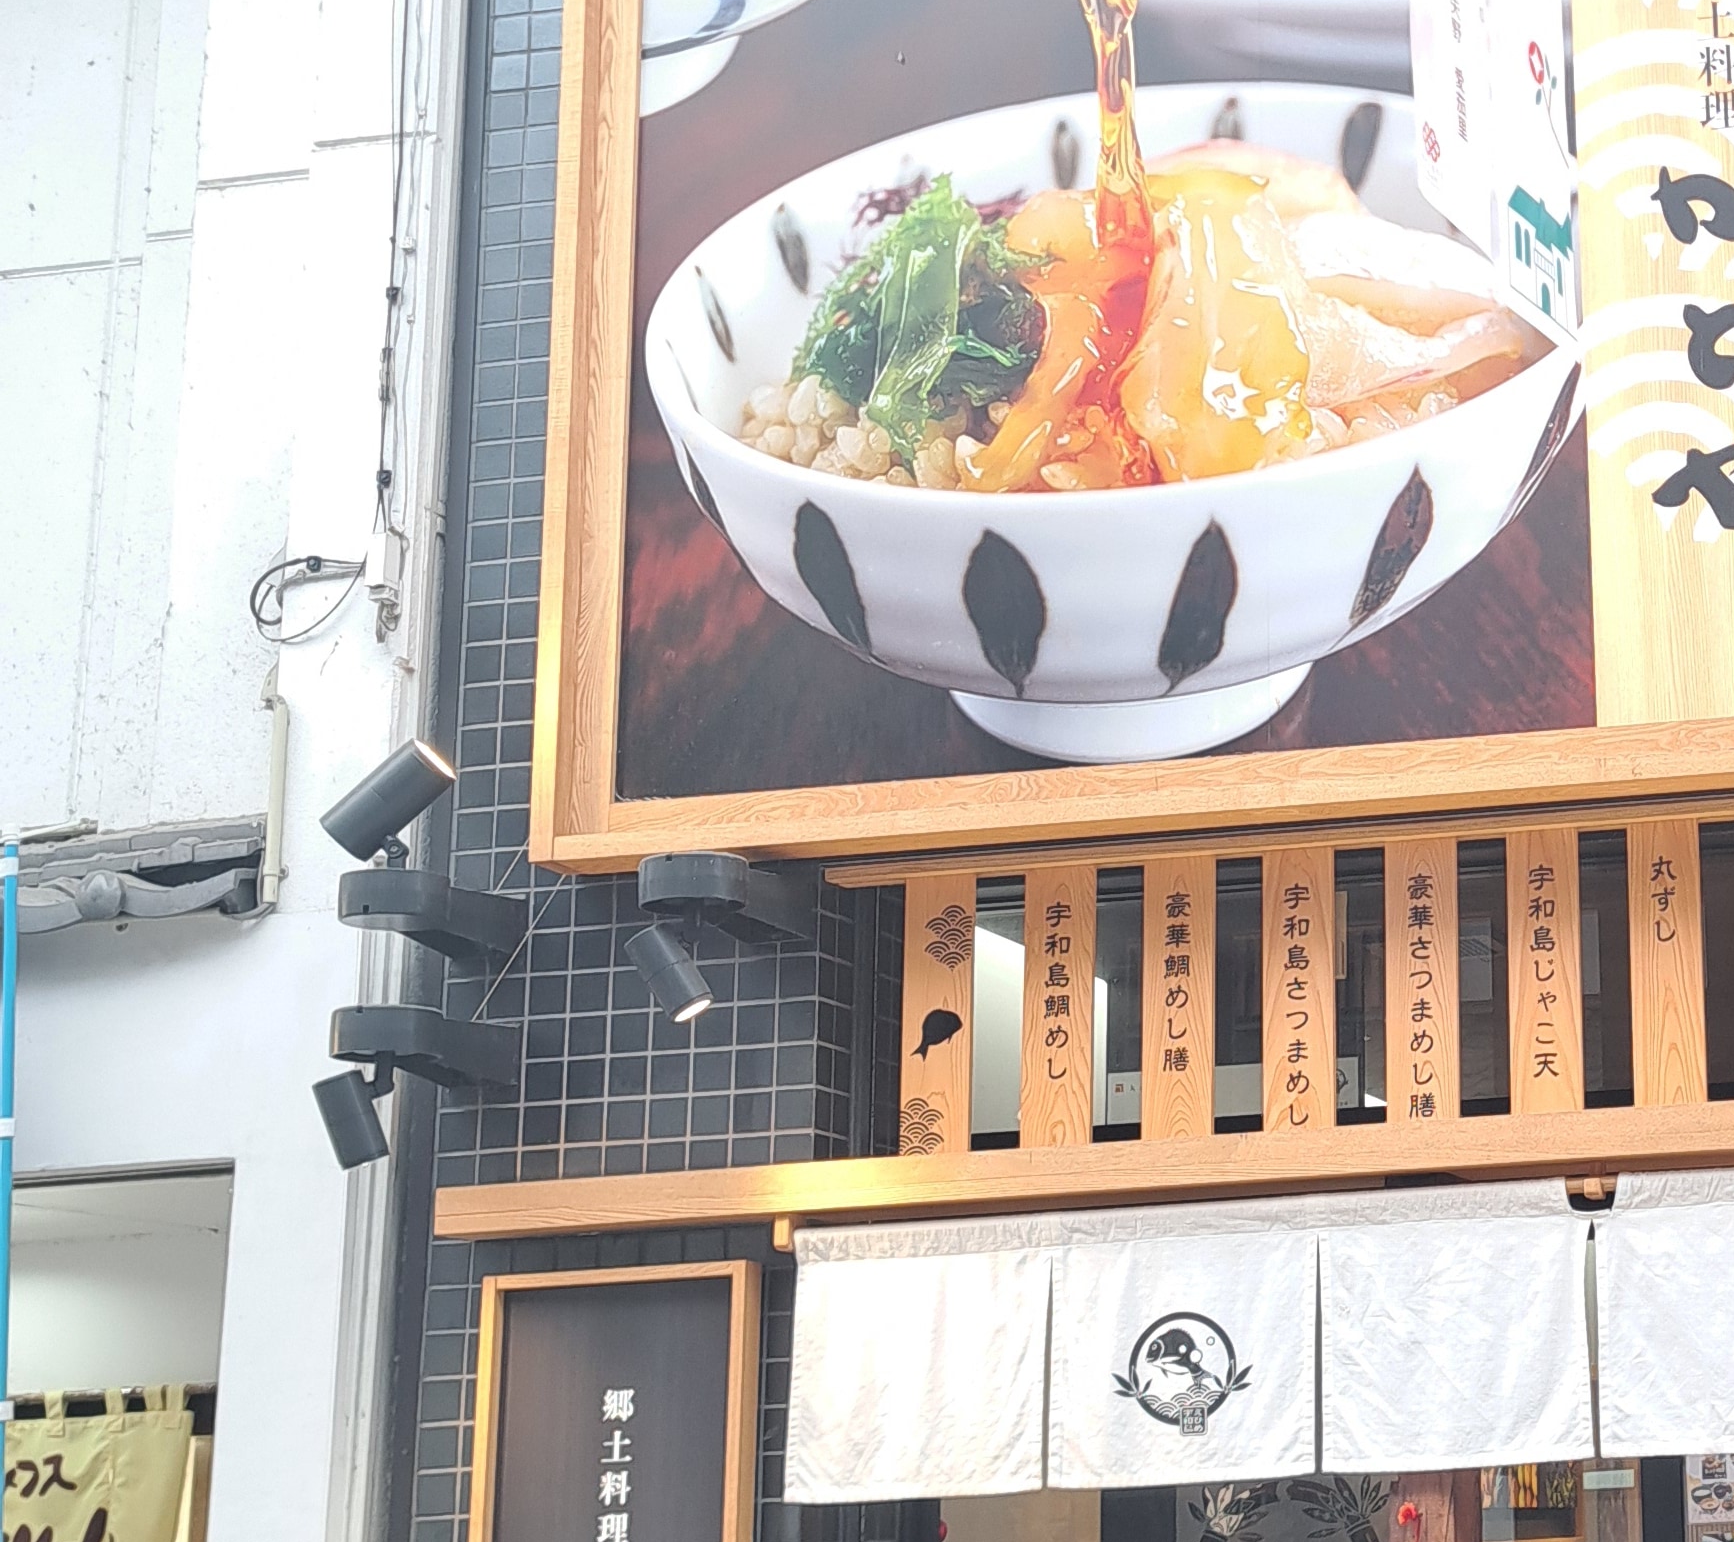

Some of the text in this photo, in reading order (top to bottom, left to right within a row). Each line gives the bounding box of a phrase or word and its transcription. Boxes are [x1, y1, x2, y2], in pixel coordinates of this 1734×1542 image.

[1043, 900, 1071, 1081] 宇和島鯛めし
[1162, 891, 1192, 1073] 豪華鯛めし膳
[1407, 872, 1436, 1119] 豪華さつまめし膳
[1527, 863, 1560, 1079] 宇和島じゃこ天
[1650, 854, 1678, 944] 丸ずし
[1283, 882, 1312, 1127] 宇和島さつまめし
